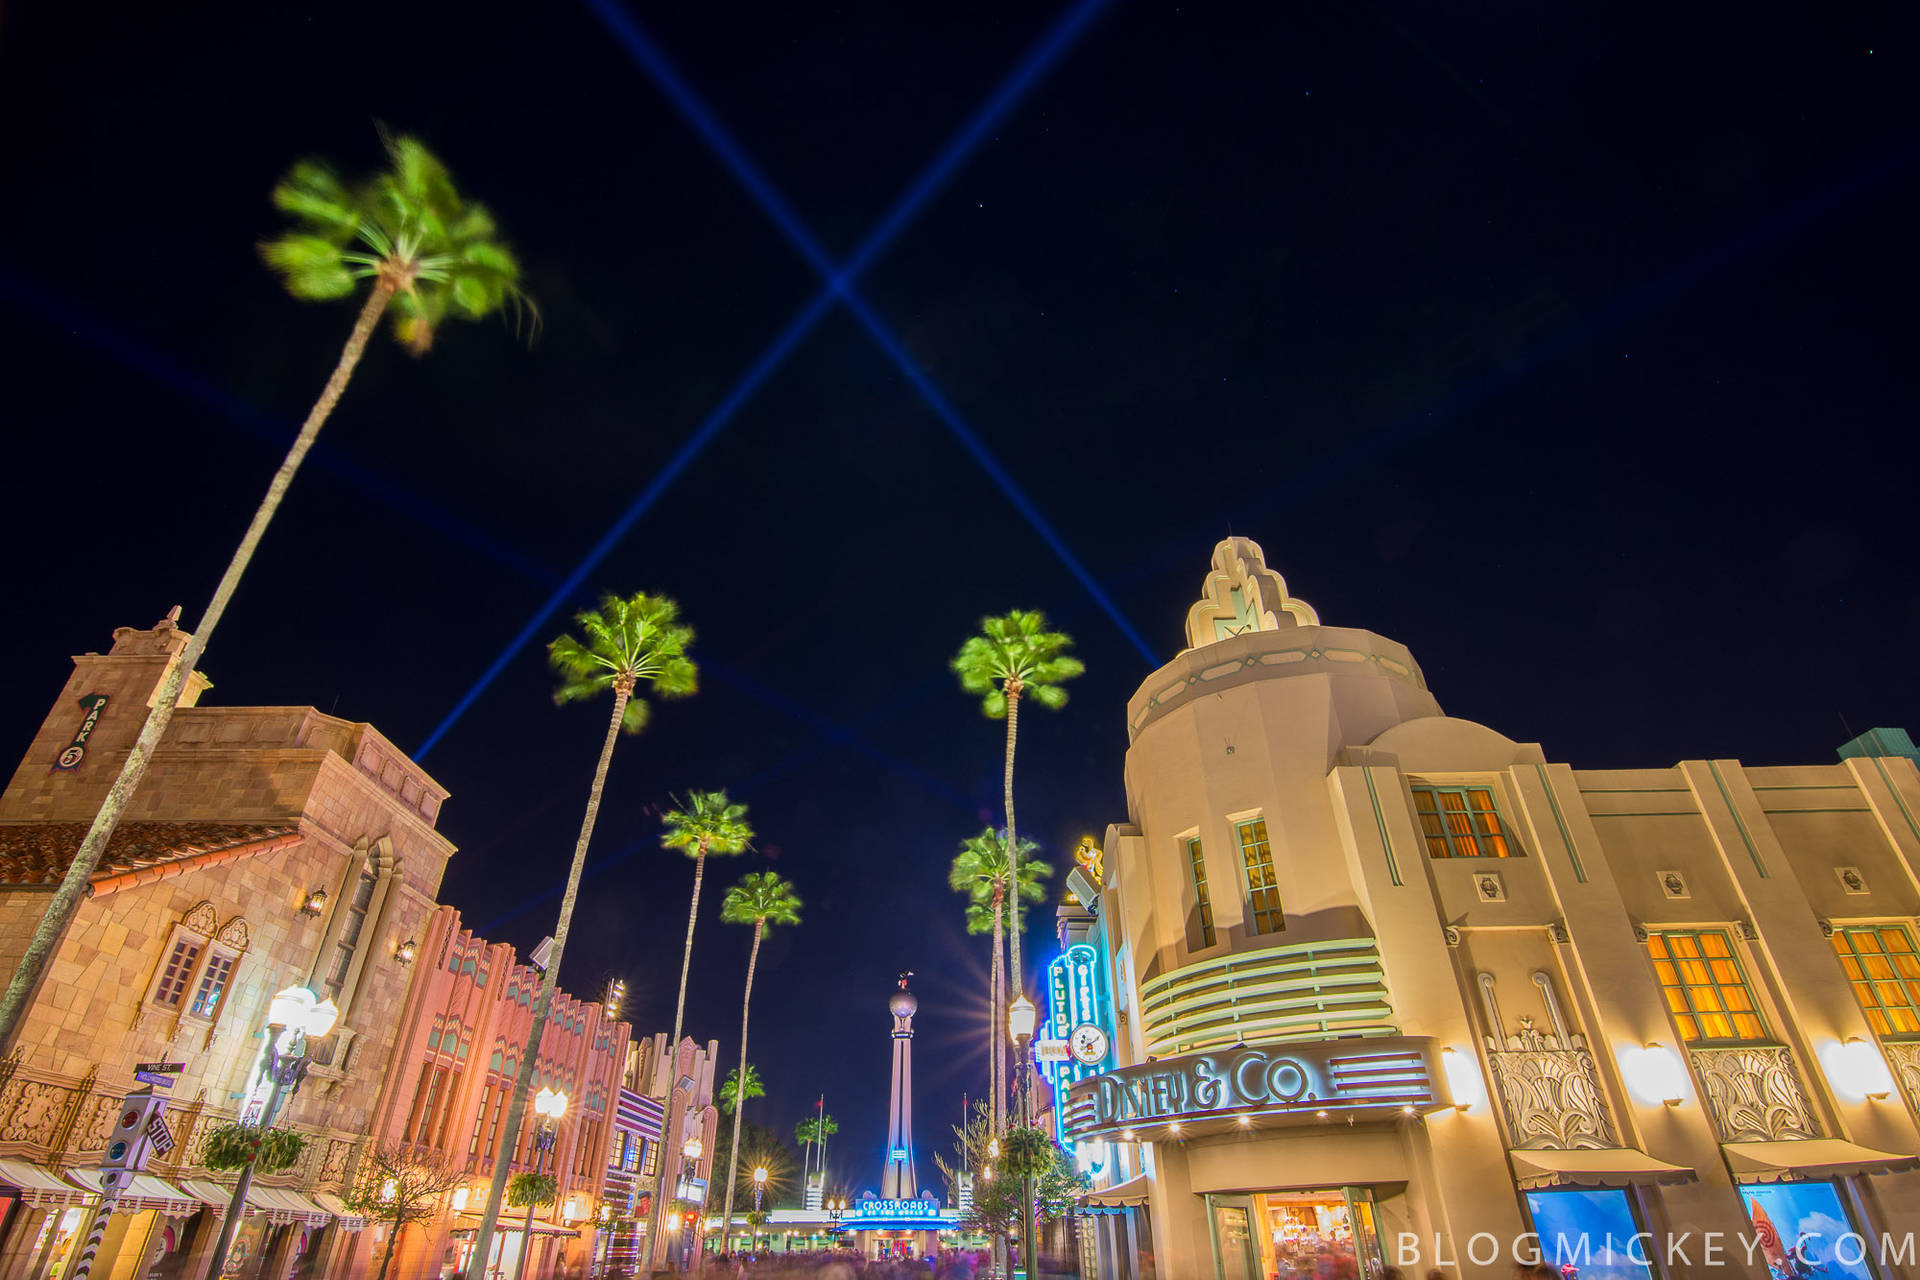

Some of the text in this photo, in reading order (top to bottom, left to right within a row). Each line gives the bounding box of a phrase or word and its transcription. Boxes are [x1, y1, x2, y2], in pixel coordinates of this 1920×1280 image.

[76, 698, 106, 742] PARK
[1053, 966, 1069, 1038] PLUTO'S
[1097, 1071, 1184, 1123] DISNEY
[1191, 1059, 1222, 1109] &
[147, 1116, 176, 1153] STOP
[862, 1201, 929, 1210] CROSSROADS
